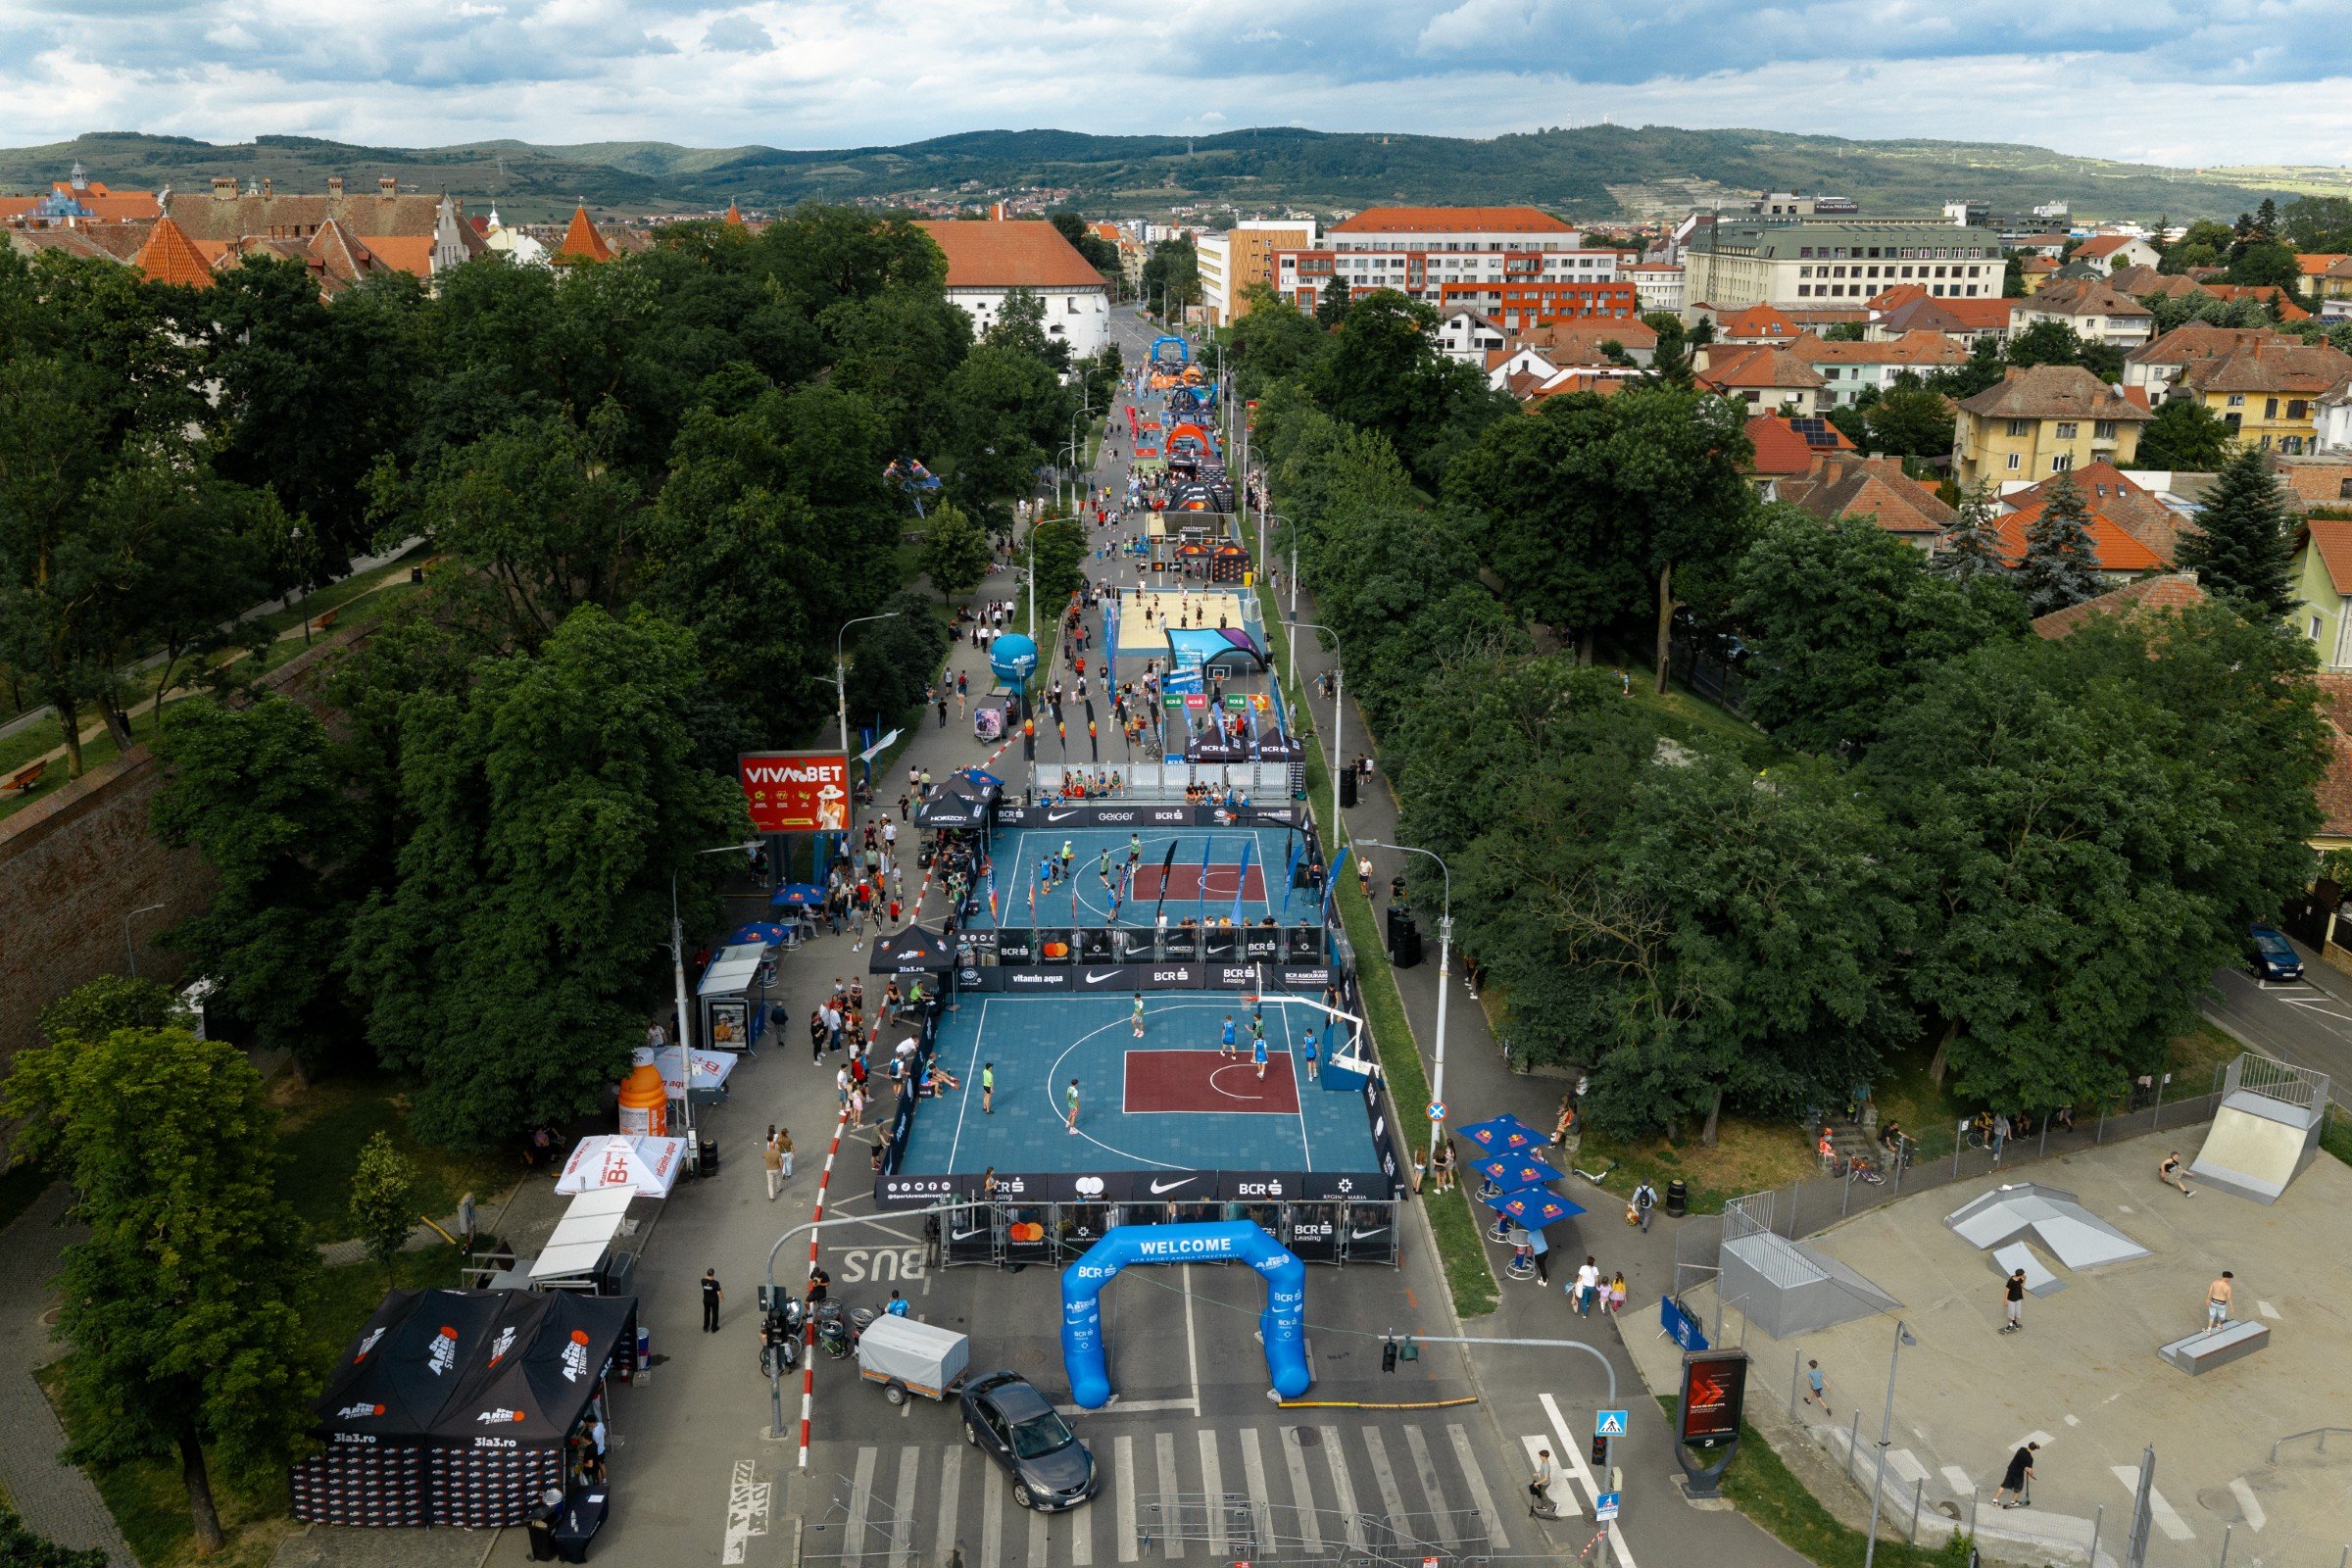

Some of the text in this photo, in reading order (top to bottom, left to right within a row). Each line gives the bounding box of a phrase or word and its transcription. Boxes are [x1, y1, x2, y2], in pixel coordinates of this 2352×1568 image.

[1013, 974, 1063, 983] vitamin aqua
[1154, 972, 1176, 981] BCR
[1223, 969, 1244, 978] BCR
[665, 1141, 676, 1156] aqua
[607, 1158, 628, 1183] B+
[1239, 1183, 1266, 1195] BCR
[1295, 1225, 1319, 1234] BCR
[1140, 1238, 1231, 1254] WELCOME
[842, 1248, 928, 1282] BUS
[1078, 1266, 1102, 1278] BCR
[1274, 1292, 1293, 1302] BCR
[334, 1433, 377, 1443] 3la3.ro
[475, 1437, 516, 1447] 3la3.ro
